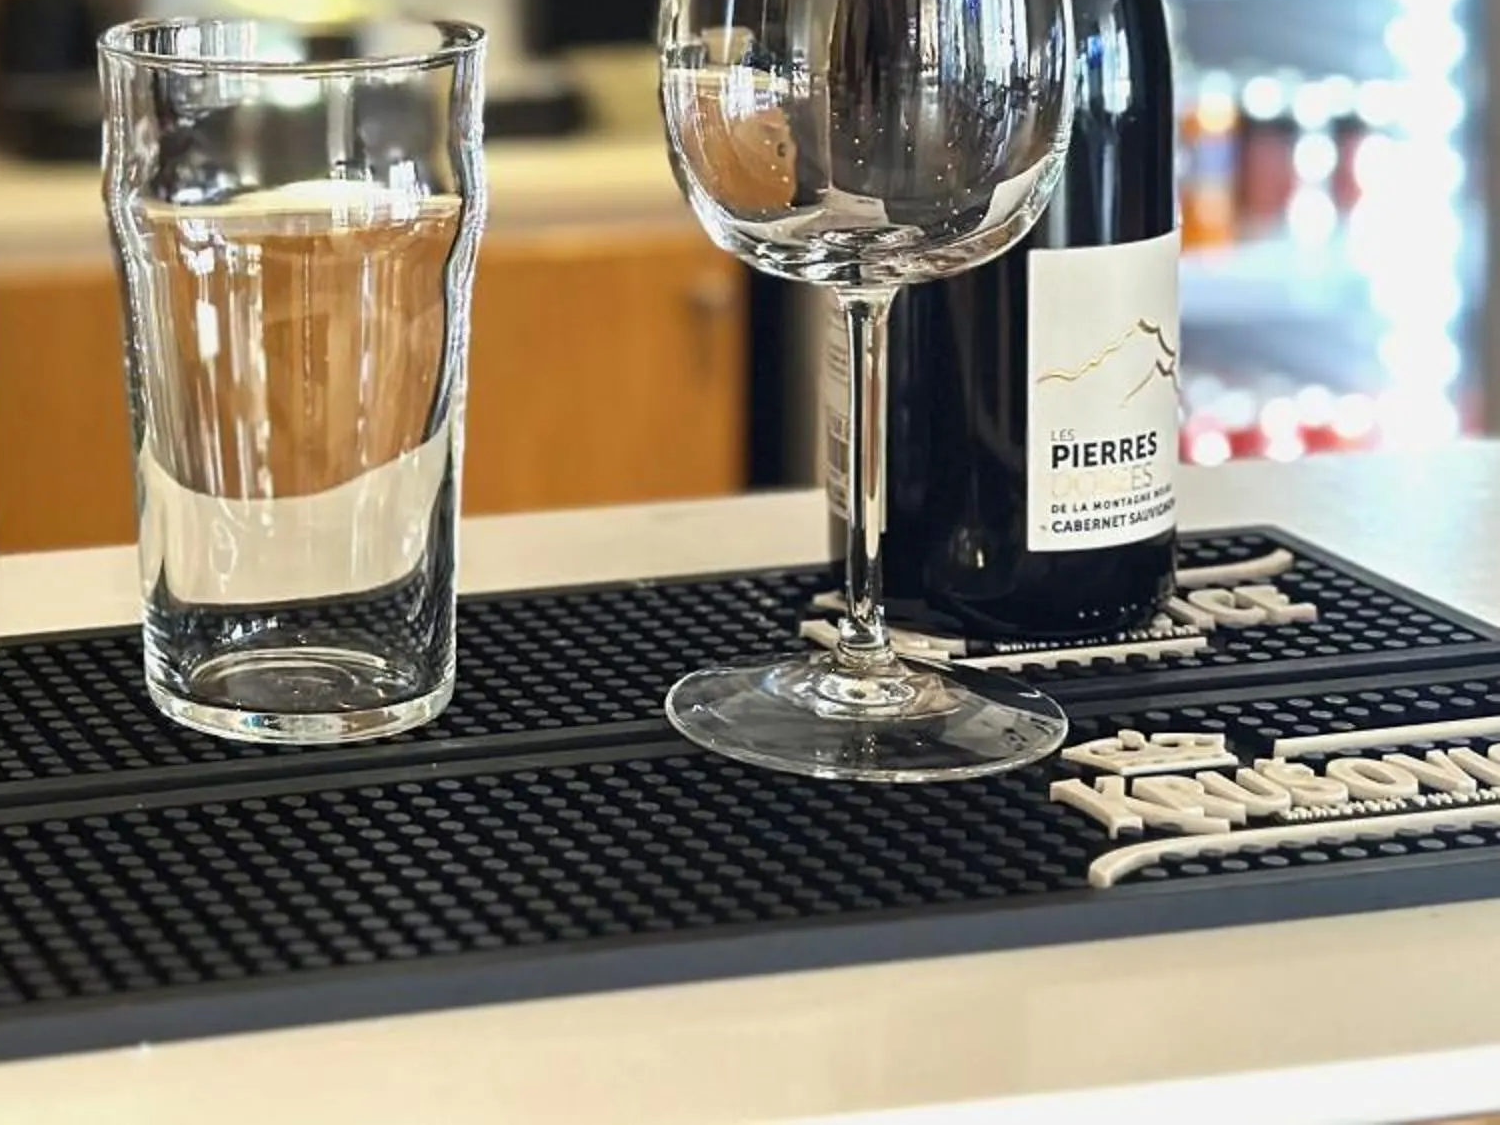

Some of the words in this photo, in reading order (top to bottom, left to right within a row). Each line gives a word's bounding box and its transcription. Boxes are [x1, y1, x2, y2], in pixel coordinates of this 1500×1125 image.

[1051, 428, 1076, 442] LES
[1051, 431, 1157, 469] PIERRES
[1051, 504, 1067, 514] DE
[1073, 502, 1088, 513] LA
[1093, 492, 1151, 511] MONTAGNE
[1051, 514, 1127, 533] CABERNET
